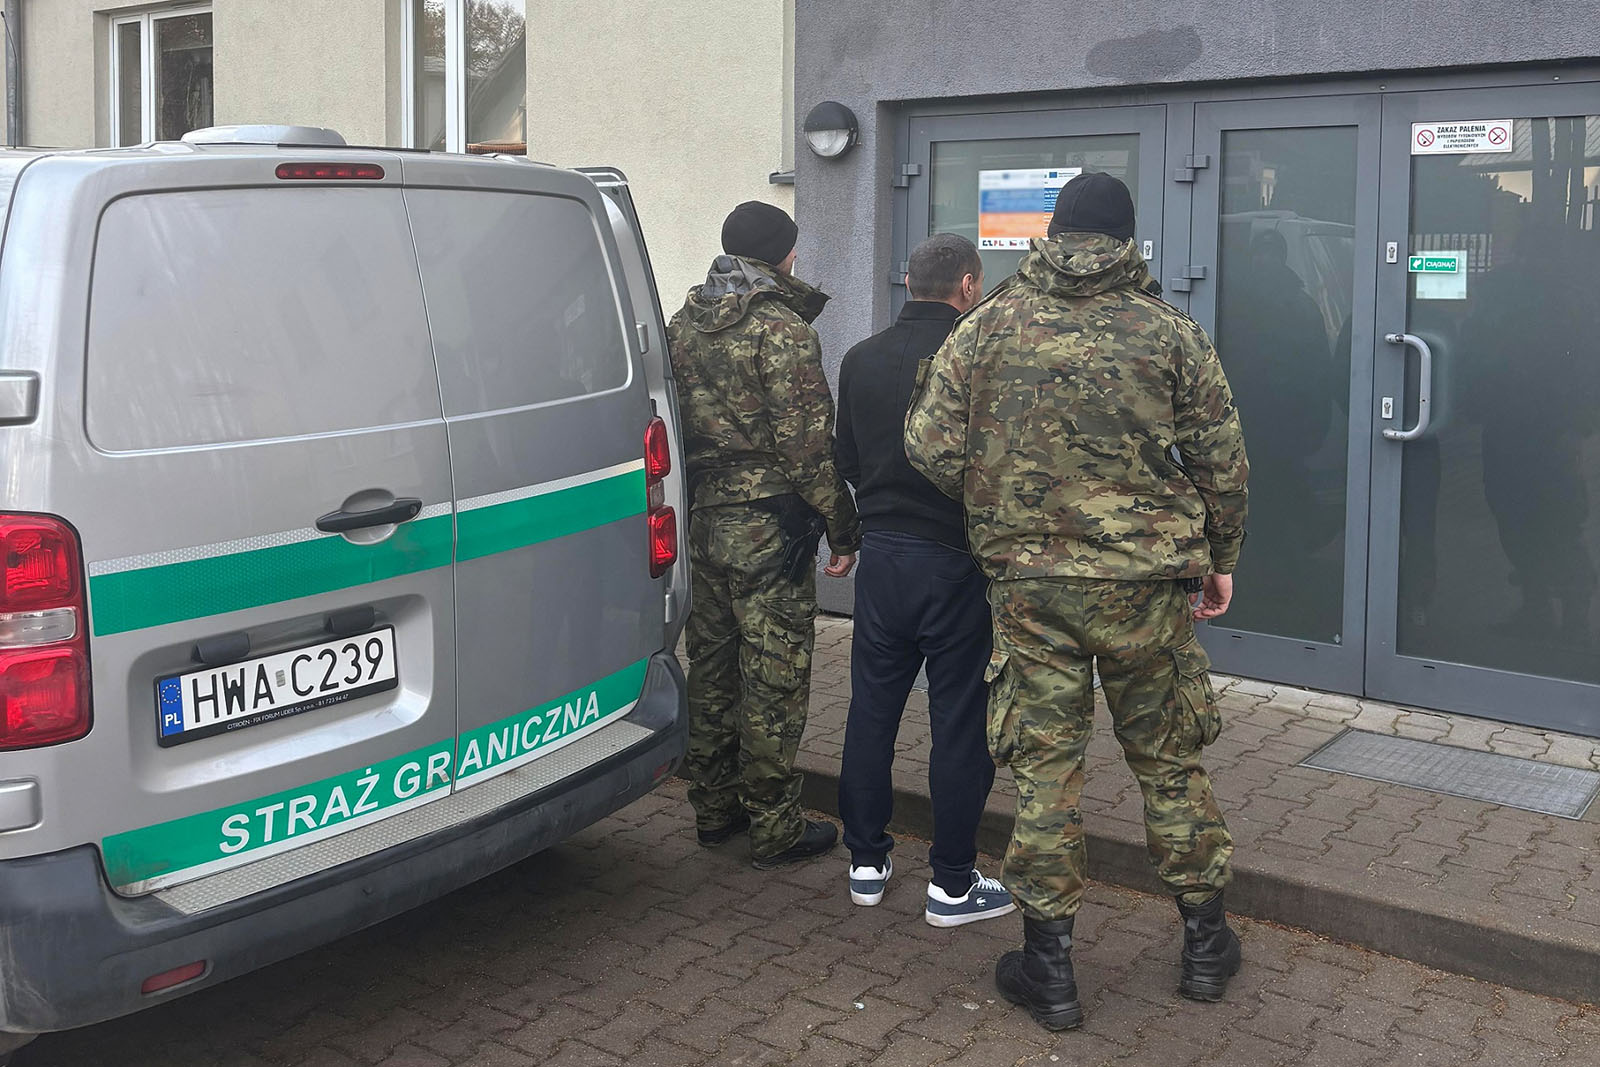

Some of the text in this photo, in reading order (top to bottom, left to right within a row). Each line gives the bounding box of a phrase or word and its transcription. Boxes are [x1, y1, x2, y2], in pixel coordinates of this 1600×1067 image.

[1426, 260, 1456, 269] CIĄGNĄĆ
[192, 637, 384, 724] HWA C239
[164, 713, 181, 727] PL
[262, 712, 280, 721] FORUM
[218, 690, 600, 854] STRAŻ GRANICZNA
